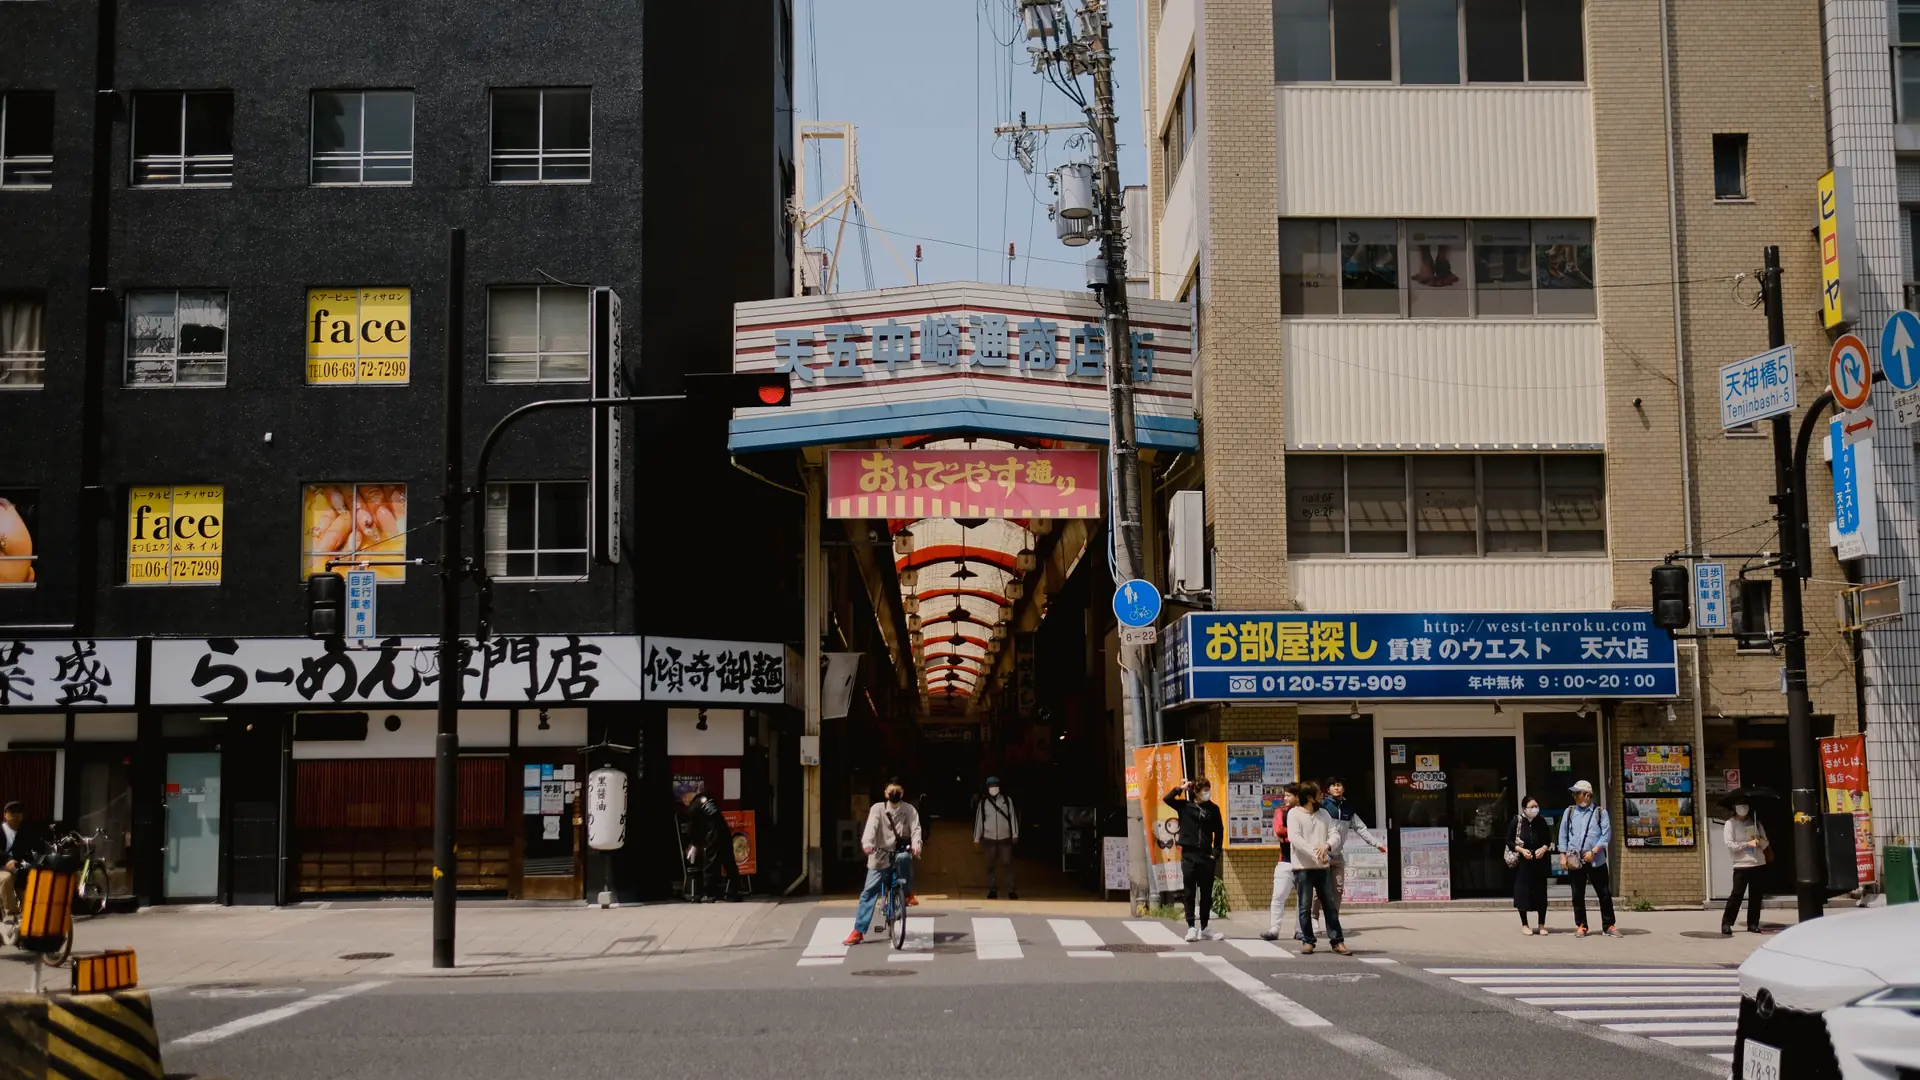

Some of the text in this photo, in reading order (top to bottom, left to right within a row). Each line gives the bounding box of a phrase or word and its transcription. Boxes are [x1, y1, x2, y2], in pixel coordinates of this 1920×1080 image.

[1820, 189, 1840, 311] ヒロヤ
[311, 292, 404, 302] ヘアービューティサロン
[310, 309, 407, 344] face
[1725, 354, 1789, 401] 天神橋5
[1726, 387, 1790, 419] Tenjinbashi-5
[859, 452, 1076, 500] おいでやす通り
[133, 490, 222, 500] トータルビーティサロン
[132, 505, 221, 540] face
[1302, 506, 1335, 519] eye:2F
[1423, 618, 1647, 636] http://west-tenroku.com
[1205, 621, 1378, 662] お部屋探し
[1580, 637, 1649, 660] 天六店
[191, 636, 602, 704] らーめん専門店
[1262, 675, 1406, 691] 0120-575-909
[1468, 675, 1525, 690] 年中無休
[1823, 742, 1849, 754] 住まい
